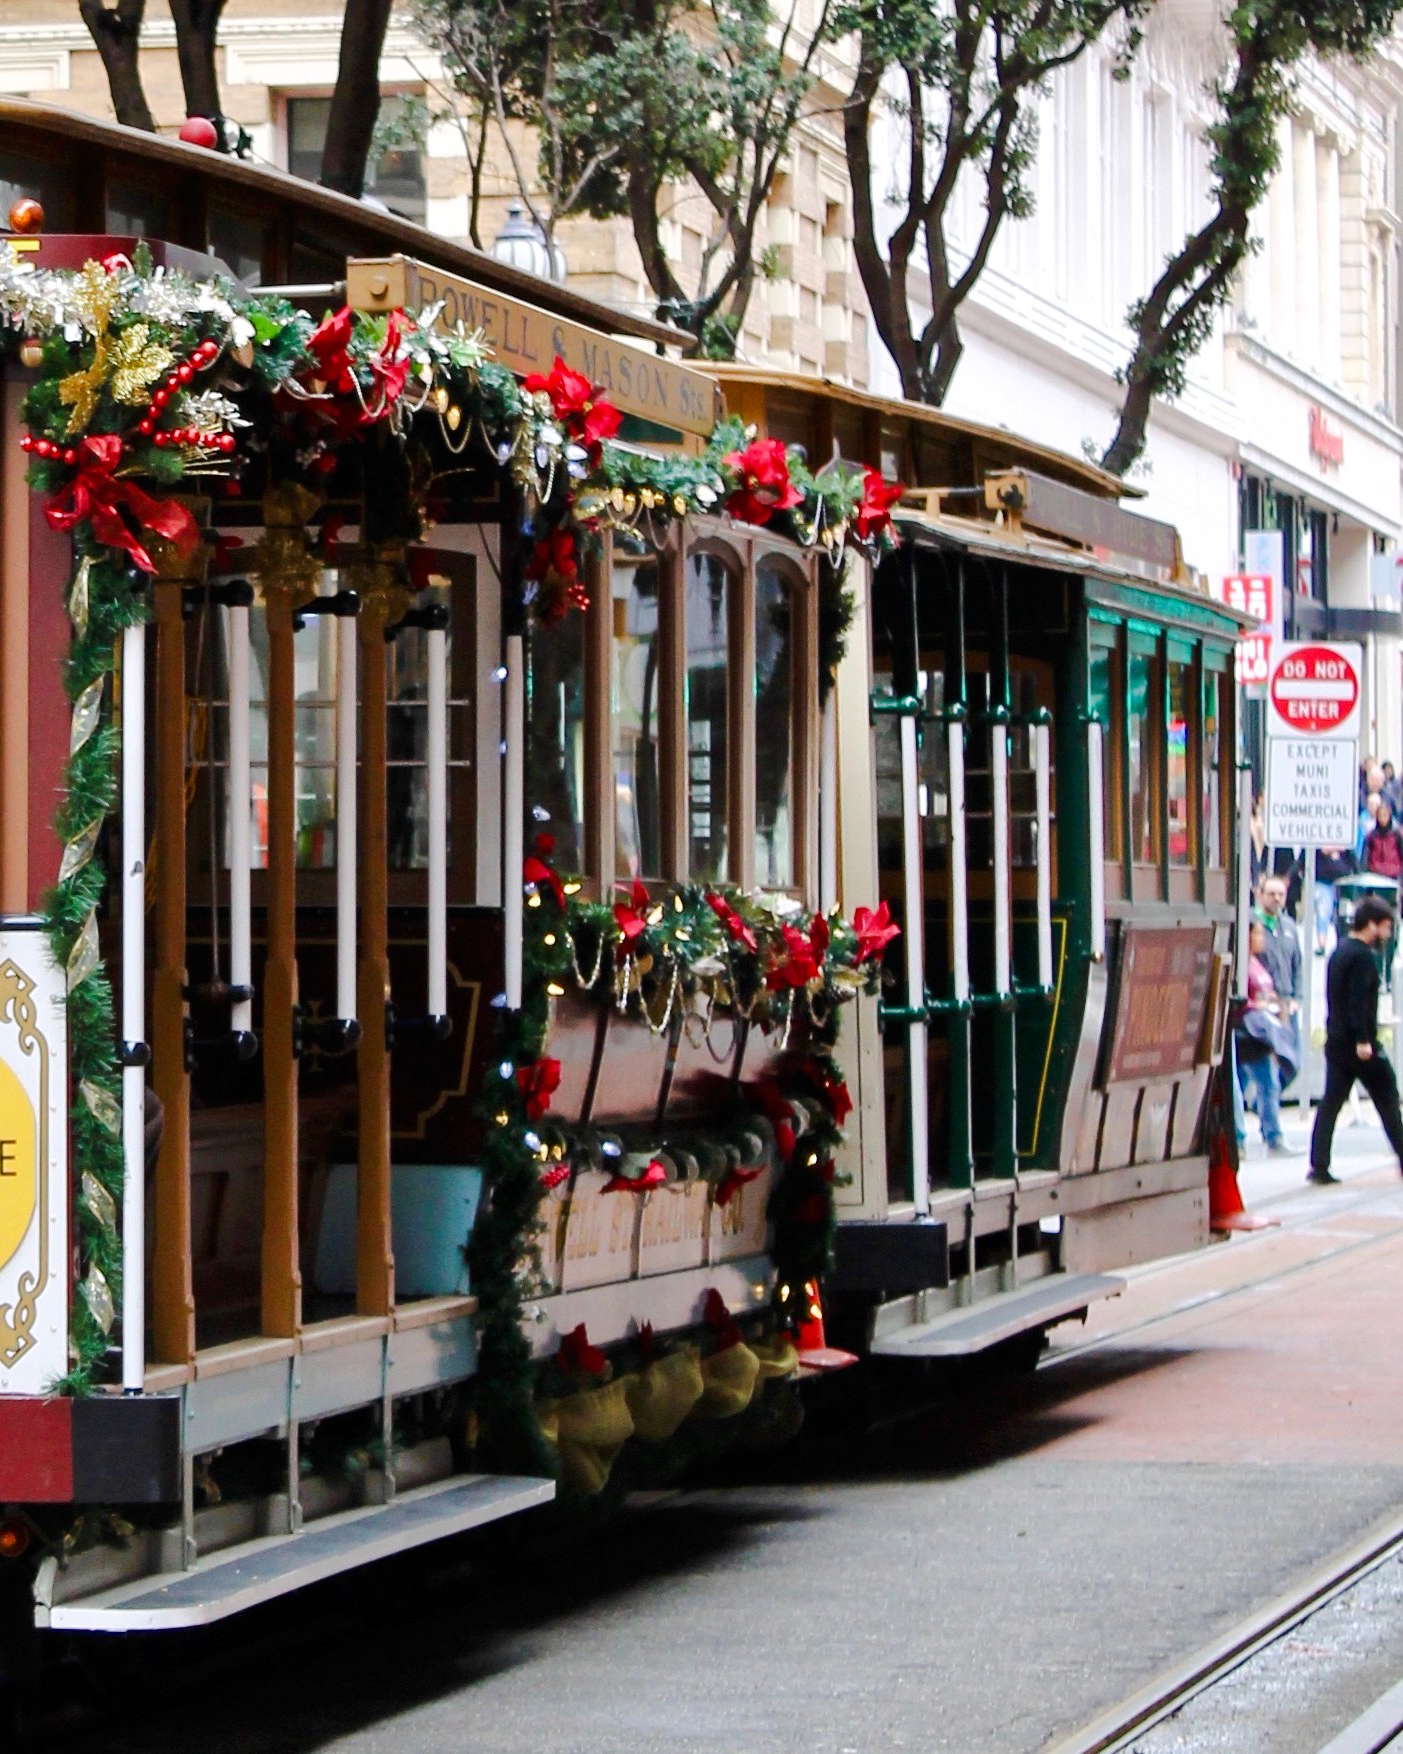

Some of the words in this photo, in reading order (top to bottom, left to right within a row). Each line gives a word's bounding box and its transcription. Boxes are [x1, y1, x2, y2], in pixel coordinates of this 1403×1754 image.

[418, 275, 537, 361] POWELL
[582, 339, 669, 408] MASON
[1283, 660, 1306, 679] DO
[1315, 660, 1347, 679] NOT
[1287, 701, 1340, 719] ENTER
[1287, 743, 1338, 759] EXCEPT
[1296, 763, 1329, 778] MUNI
[1294, 782, 1331, 799] TAXIS
[1272, 801, 1348, 820] COMMERCIAL
[1279, 821, 1343, 840] VEHICLES
